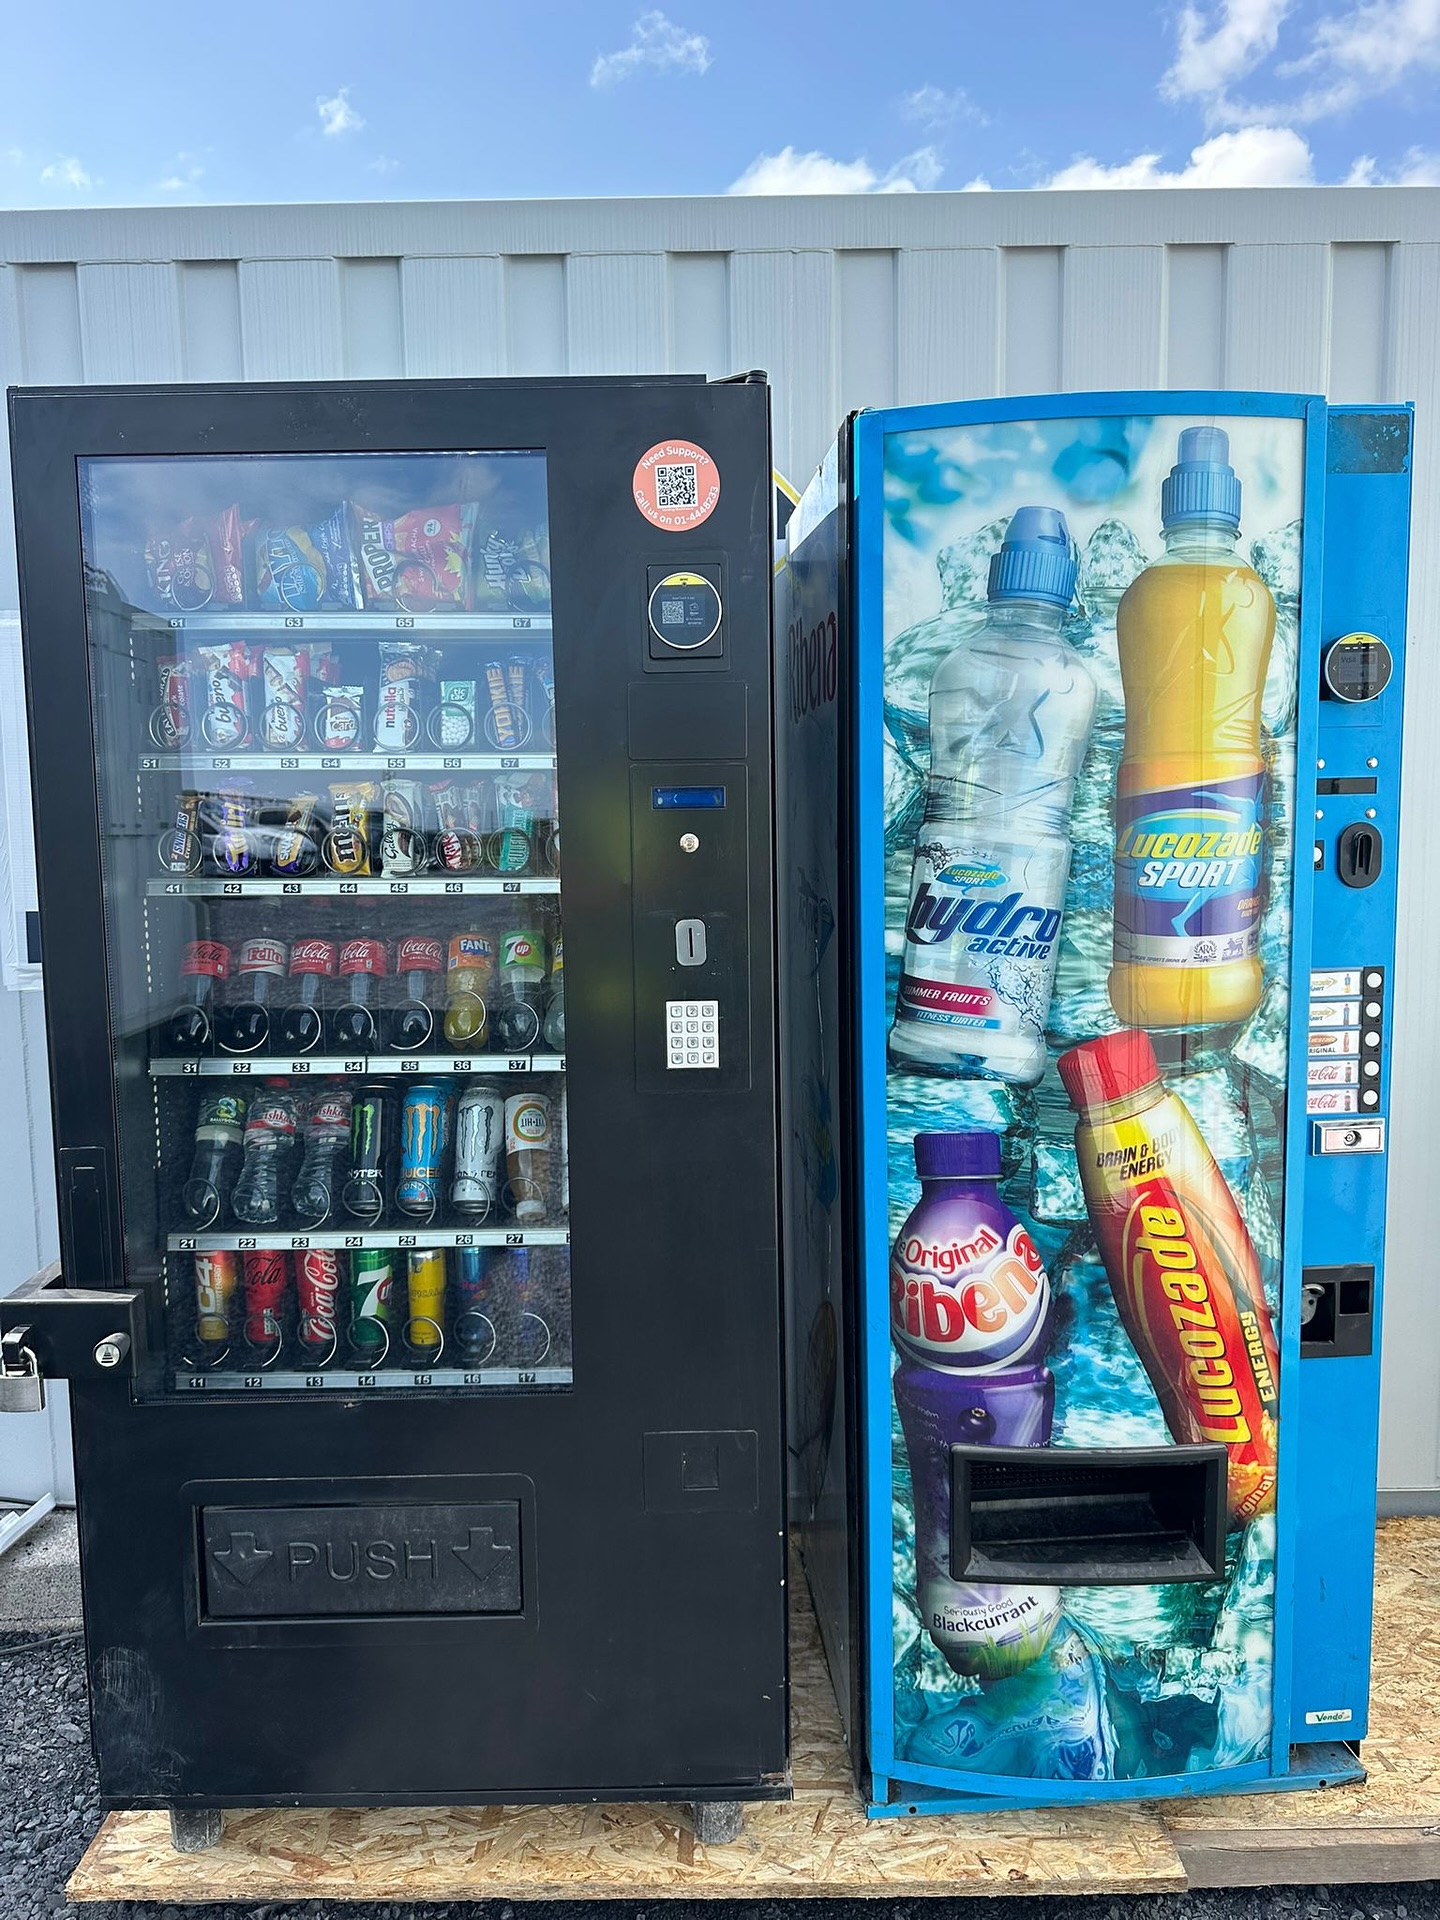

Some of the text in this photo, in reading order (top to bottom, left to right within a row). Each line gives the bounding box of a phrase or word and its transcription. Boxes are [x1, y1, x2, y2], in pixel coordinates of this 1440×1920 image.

[641, 446, 710, 470] Need Support?
[635, 485, 719, 525] Call us on 01-4448233
[362, 514, 395, 593] PROPER
[170, 619, 183, 627] 61
[286, 619, 301, 627] 63
[397, 619, 413, 627] 65
[514, 619, 529, 627] 67
[787, 610, 837, 726] Ribena
[453, 687, 466, 697] tic
[142, 759, 157, 768] 51
[215, 759, 228, 768] 52
[282, 759, 297, 768] 53
[323, 759, 338, 767] 54
[389, 759, 404, 767] 55
[445, 759, 459, 767] 56
[503, 758, 517, 767] 57
[382, 818, 399, 860] Galaxy
[1114, 823, 1264, 859] Lucozade
[943, 865, 999, 880] Lucozade
[1138, 860, 1245, 889] SPORT
[952, 875, 988, 886] SPORT
[165, 884, 180, 893] 41
[225, 884, 240, 893] 42
[284, 884, 299, 893] 43
[340, 884, 356, 893] 44
[391, 884, 407, 893] 45
[446, 883, 462, 892] 46
[504, 883, 519, 892] 47
[906, 882, 1062, 945] hydro
[965, 932, 1051, 961] active
[941, 990, 993, 1007] FRUITS
[950, 1015, 988, 1028] WATER
[183, 1064, 198, 1073] 31
[234, 1064, 250, 1073] 32
[293, 1063, 308, 1072] 33
[346, 1063, 361, 1072] 34
[402, 1061, 418, 1070] 35
[454, 1061, 470, 1070] 36
[509, 1060, 525, 1070] 37
[1096, 1145, 1138, 1168] BRAIN
[1140, 1143, 1149, 1158] &
[1120, 1147, 1173, 1181] ENERGY
[180, 1238, 195, 1248] 21
[239, 1238, 255, 1248] 22
[293, 1238, 308, 1247] 23
[346, 1237, 361, 1246] 24
[400, 1236, 415, 1245] 25
[457, 1235, 472, 1244] 26
[507, 1234, 522, 1243] 27
[904, 1227, 1001, 1276] Original
[891, 1228, 1044, 1343] Ribena
[1137, 1204, 1252, 1444] Lucozade
[1240, 1309, 1277, 1403] ENERGY
[307, 1377, 322, 1386] 13
[359, 1377, 374, 1386] 14
[416, 1375, 430, 1384] 15
[465, 1374, 480, 1383] 16
[520, 1373, 534, 1382] 17
[190, 1378, 204, 1387] 11
[245, 1378, 261, 1387] 12
[287, 1540, 440, 1583] PUSH
[943, 1596, 1014, 1618] Seriously Good
[932, 1594, 1040, 1634] Blackcurrant
[1315, 1712, 1343, 1722] Vendo
